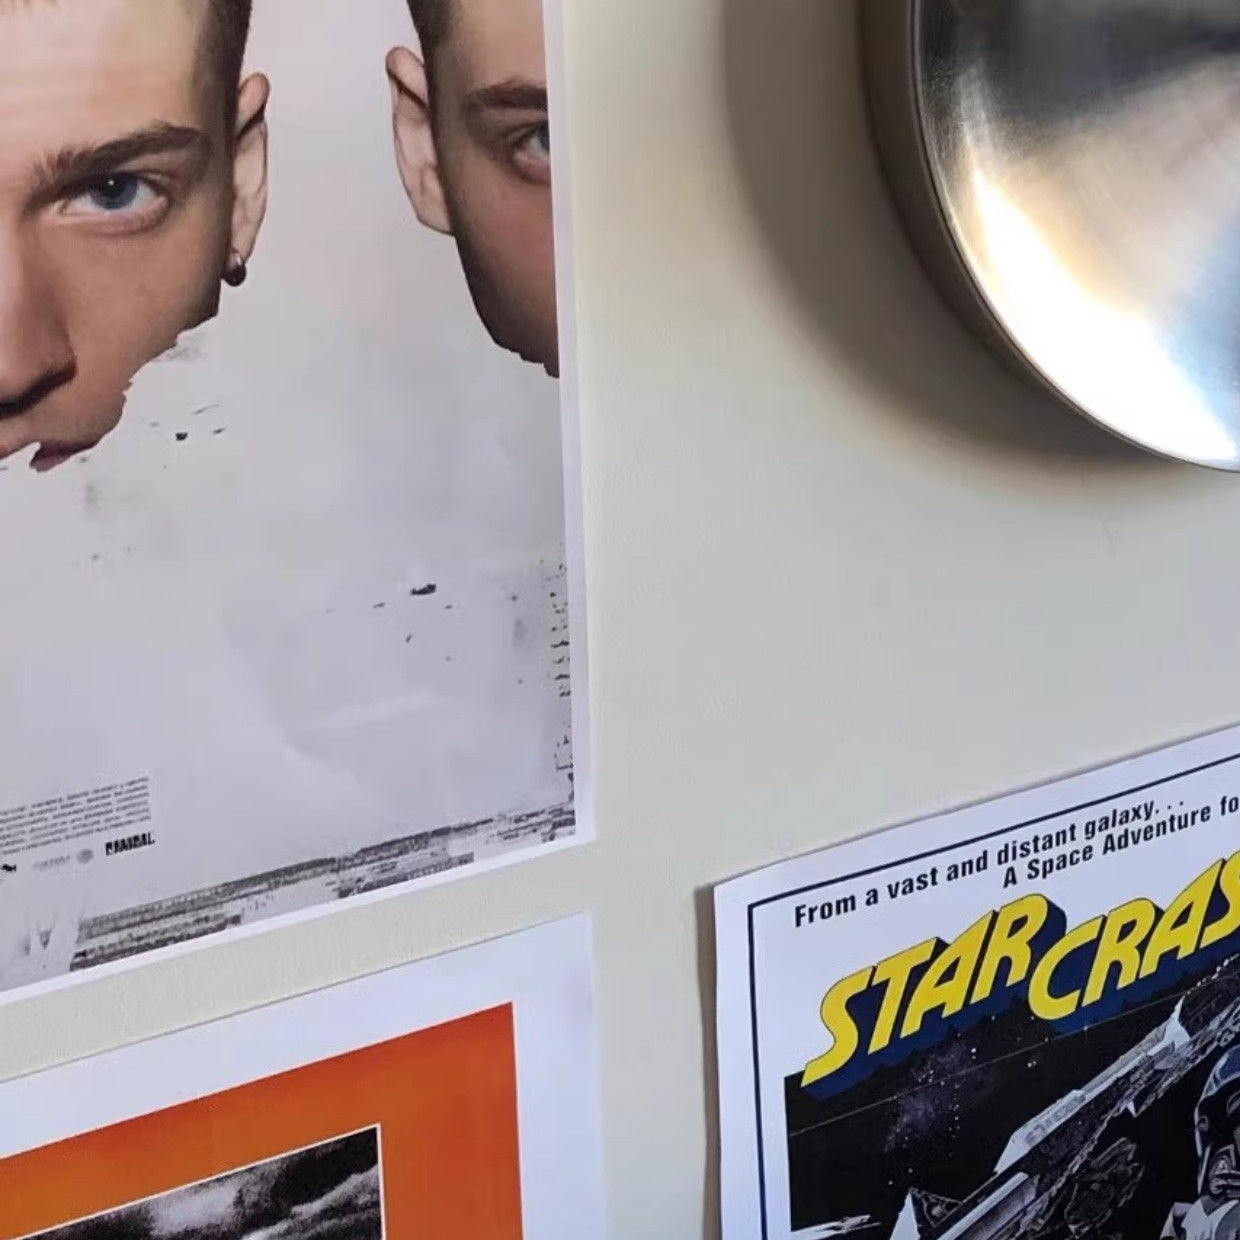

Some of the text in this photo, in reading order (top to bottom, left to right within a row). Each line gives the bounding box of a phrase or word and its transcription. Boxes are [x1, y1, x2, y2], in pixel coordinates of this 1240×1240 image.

[795, 894, 856, 928] From
[865, 887, 879, 907] a
[887, 868, 939, 899] vast
[946, 850, 988, 882] and
[997, 822, 1077, 866] distant
[1003, 866, 1017, 888] A
[1027, 844, 1094, 880] Space
[1102, 805, 1211, 855] Adventure
